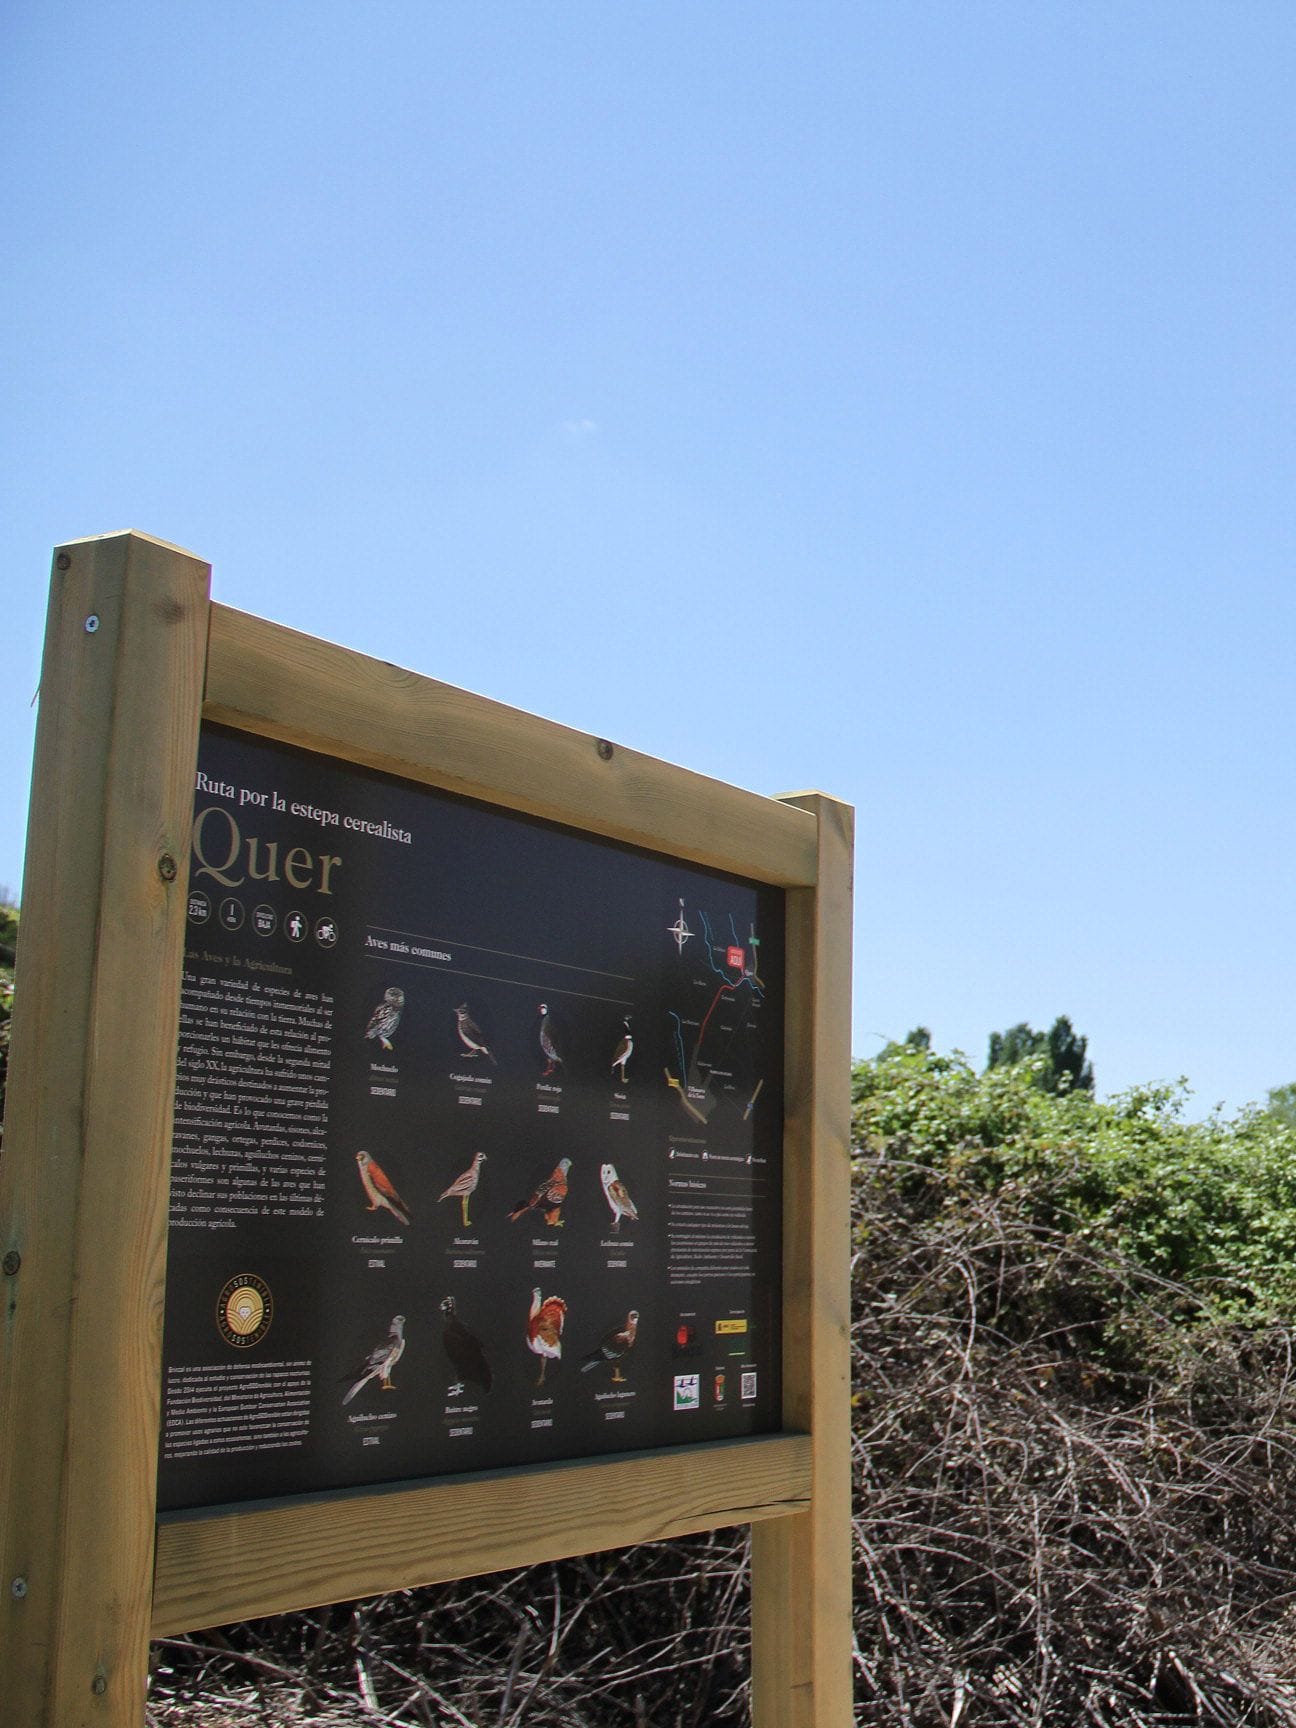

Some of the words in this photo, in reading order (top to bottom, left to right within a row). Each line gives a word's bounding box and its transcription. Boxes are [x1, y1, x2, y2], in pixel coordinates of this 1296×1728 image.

[194, 771, 235, 799] Ruta
[239, 787, 269, 806] por
[290, 801, 340, 827] estepa
[343, 816, 413, 845] cerealista
[192, 806, 343, 895] Quer
[365, 934, 389, 951] Aves
[390, 938, 409, 955] más
[411, 946, 452, 962] comunes
